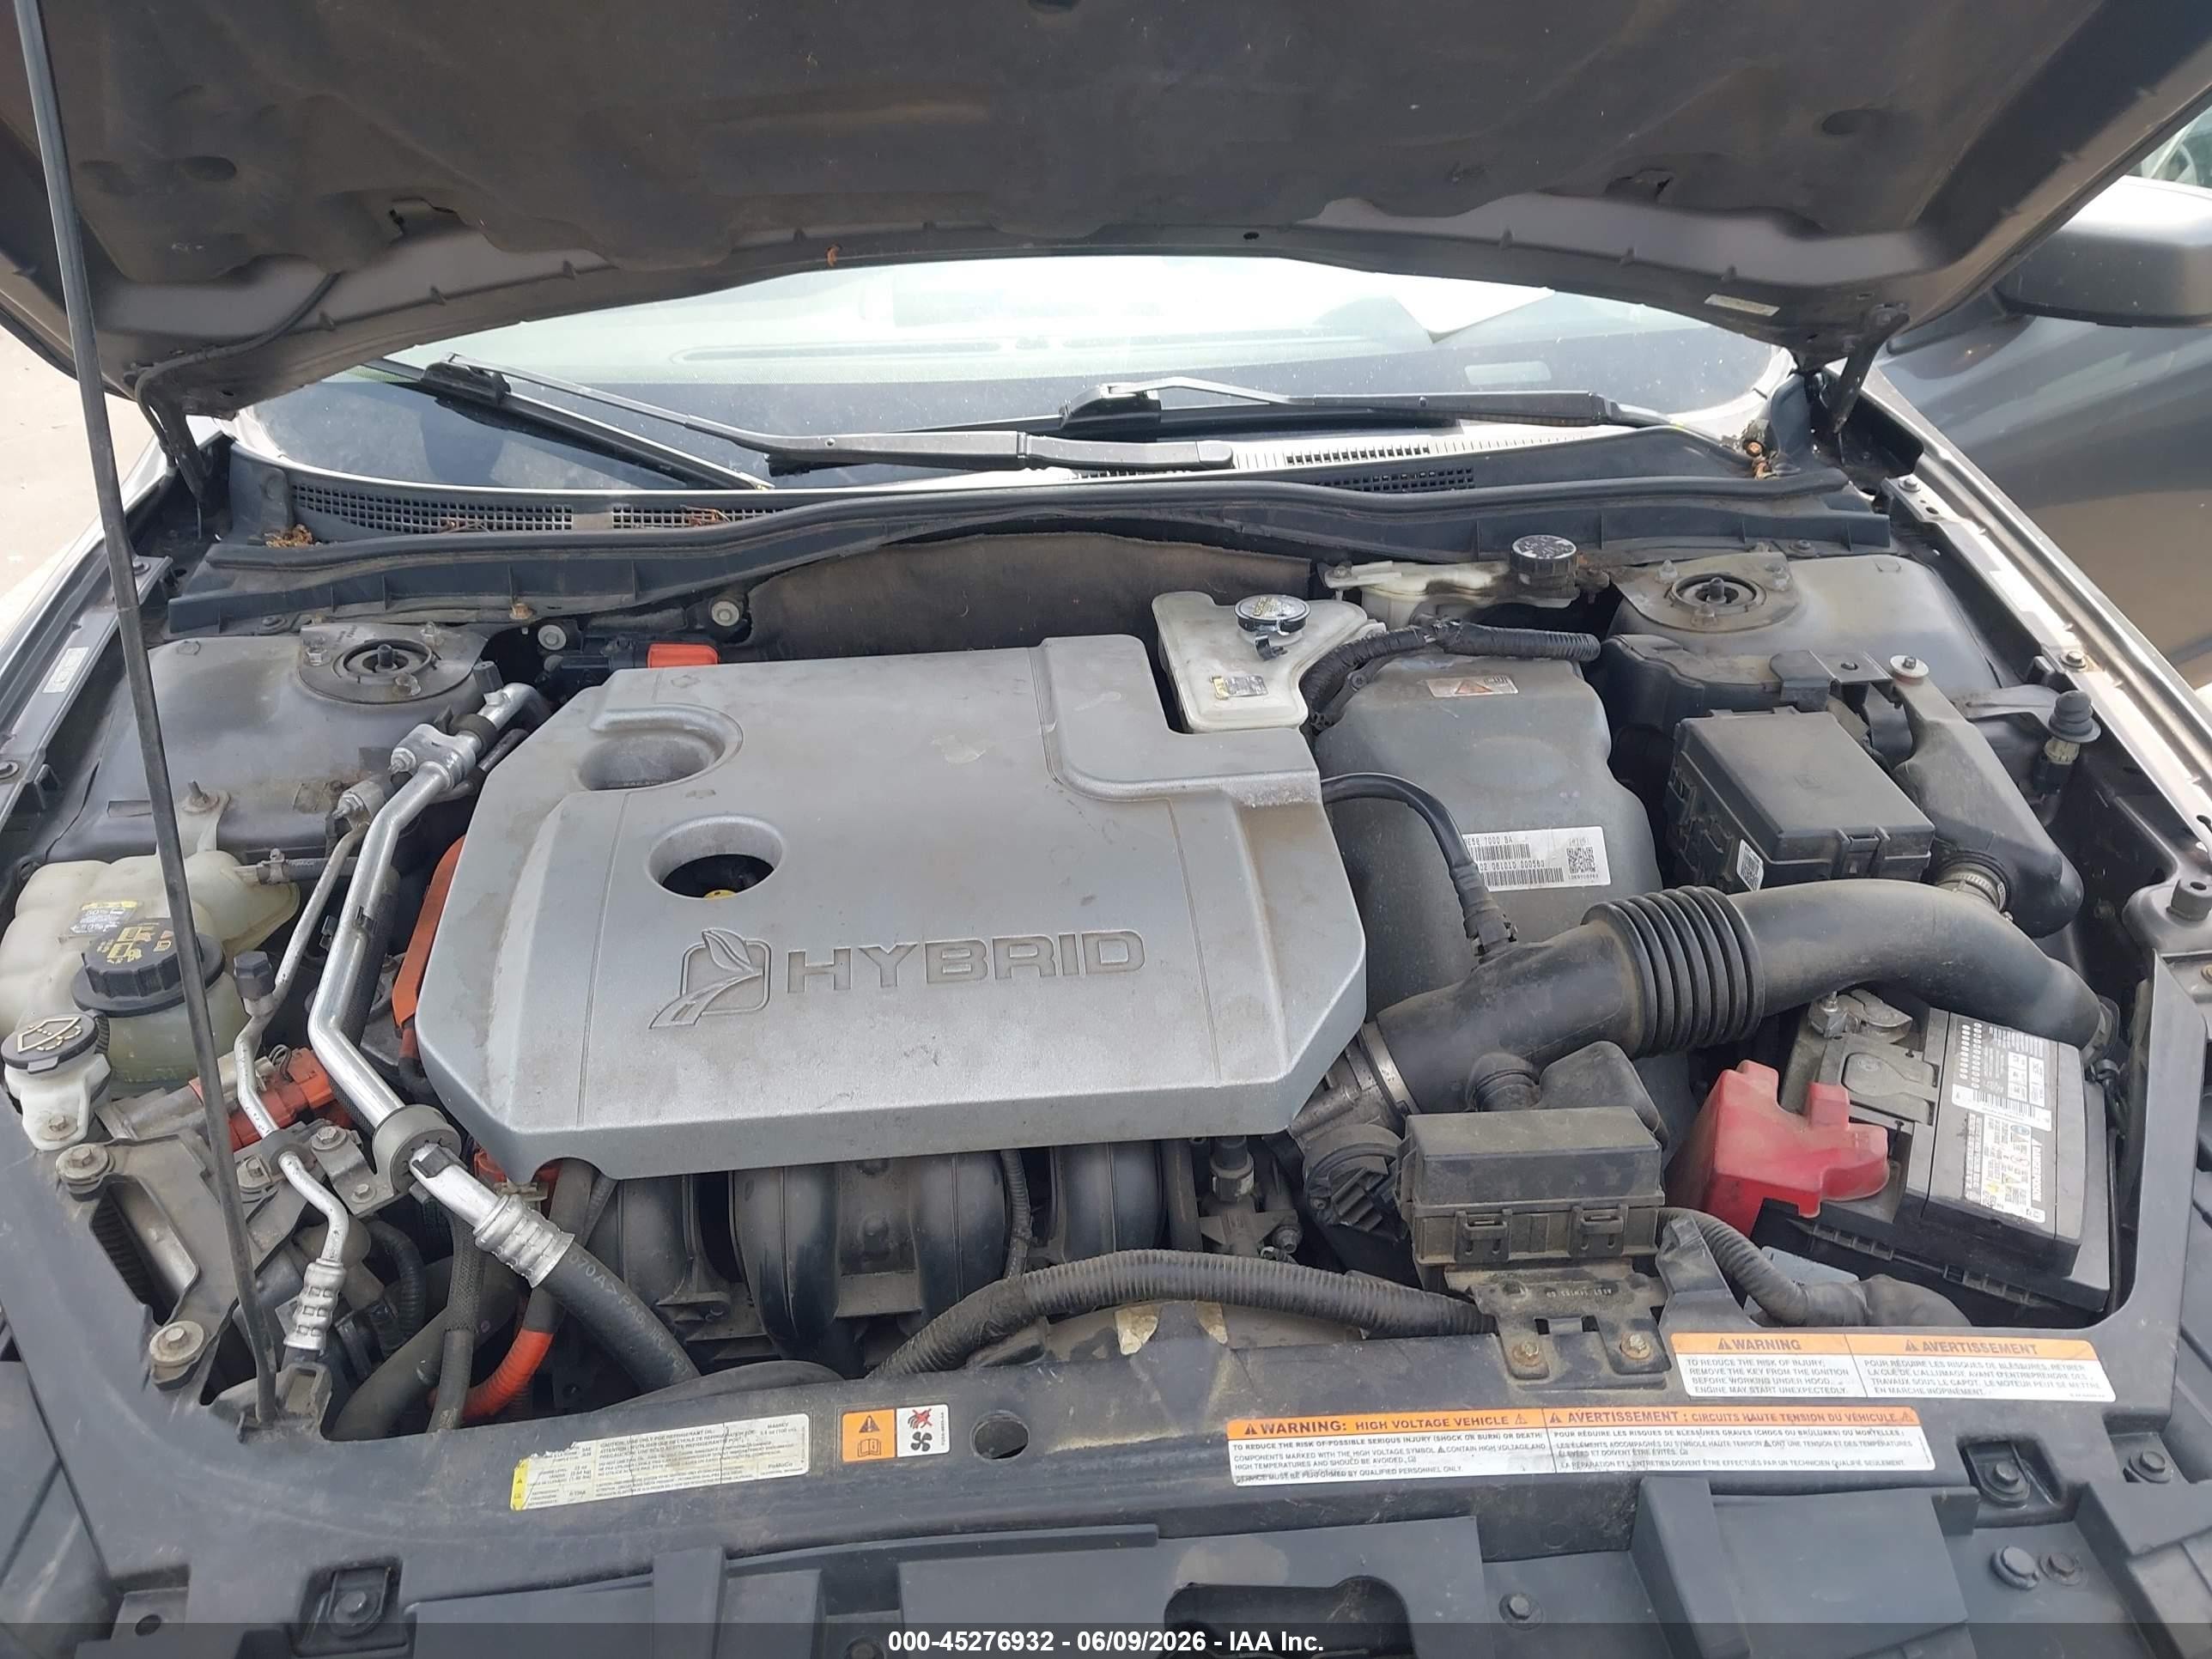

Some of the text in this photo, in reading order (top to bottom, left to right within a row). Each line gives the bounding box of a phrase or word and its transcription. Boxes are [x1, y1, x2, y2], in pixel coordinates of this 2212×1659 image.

[787, 928, 1146, 994] HYBRID
[1732, 1339, 1802, 1351] WARNING
[1923, 1340, 2038, 1354] AVERTISSEMENT
[1568, 1411, 1679, 1423] AVERTISSEMENT
[1692, 1413, 1740, 1422] CIRCUITS
[1743, 1413, 1778, 1423] HAUTE
[1780, 1413, 1825, 1423] TENSION
[1827, 1413, 1843, 1422] DU
[1261, 1416, 1510, 1435] WARNING: HIGH VOLTAGE VEHICLE
[1676, 1429, 1720, 1438] BLESSURES
[1245, 1442, 1276, 1450] REDUCE
[1327, 1438, 1365, 1447] POSSIBLE
[1367, 1437, 1401, 1445] SERIOUS
[1433, 1434, 1462, 1443] (SHOCK
